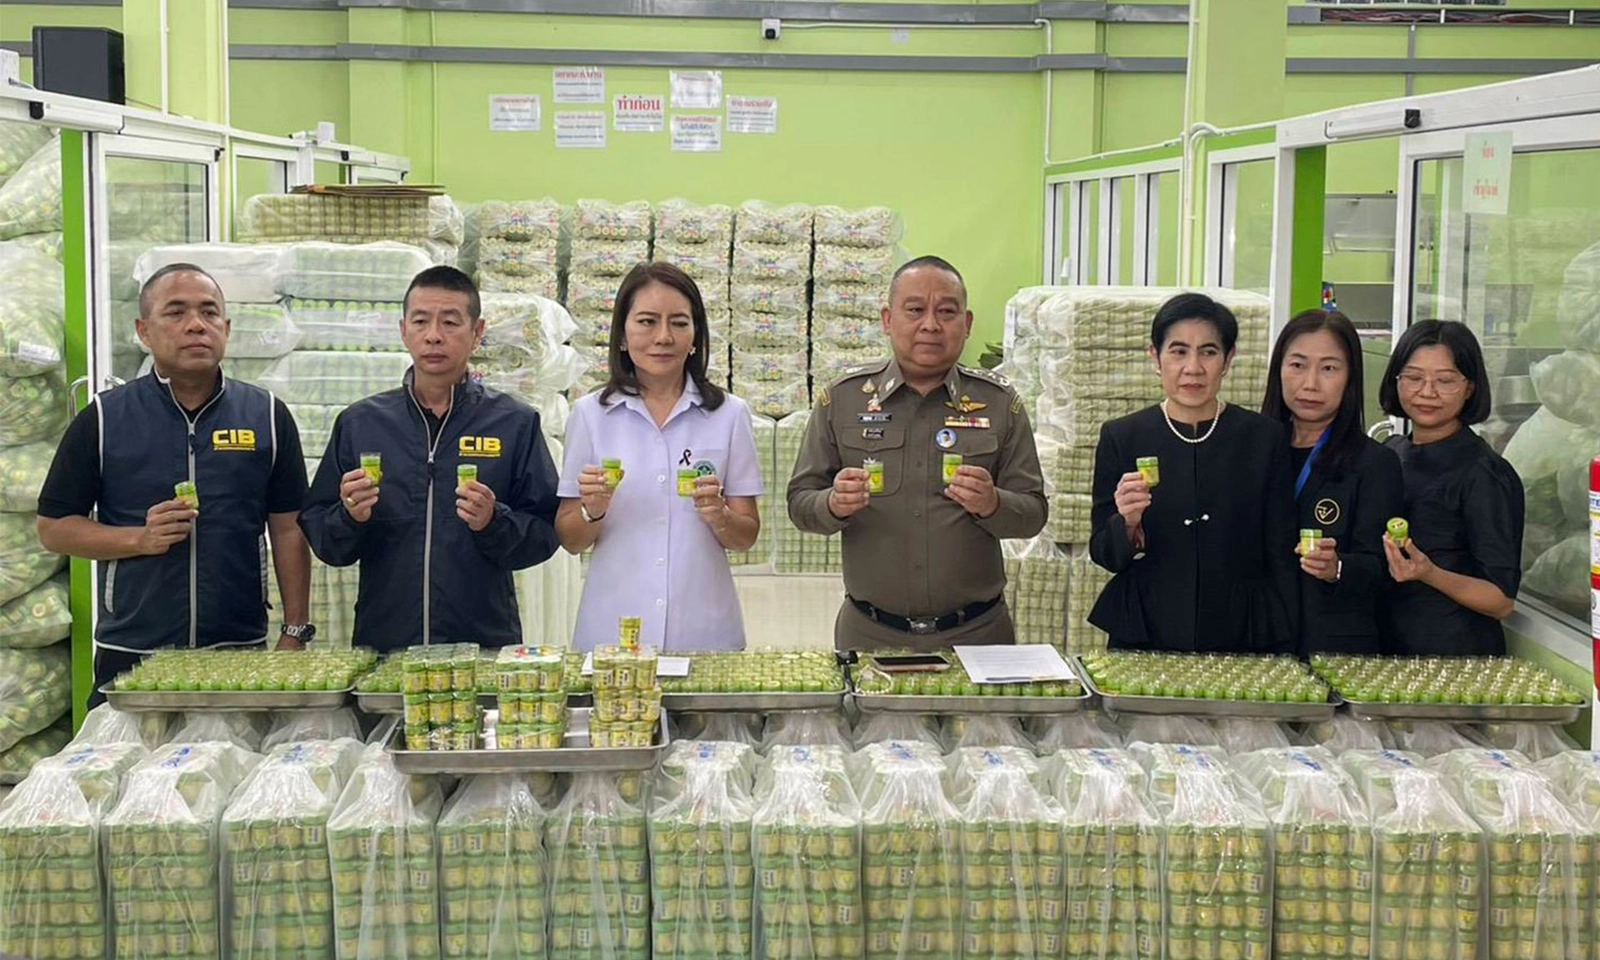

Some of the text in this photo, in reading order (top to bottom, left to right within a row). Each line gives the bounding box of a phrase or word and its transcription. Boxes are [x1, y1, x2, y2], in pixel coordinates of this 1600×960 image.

[616, 95, 661, 111] ทำก่อน
[212, 429, 256, 444] CIB
[458, 436, 502, 451] CIB
